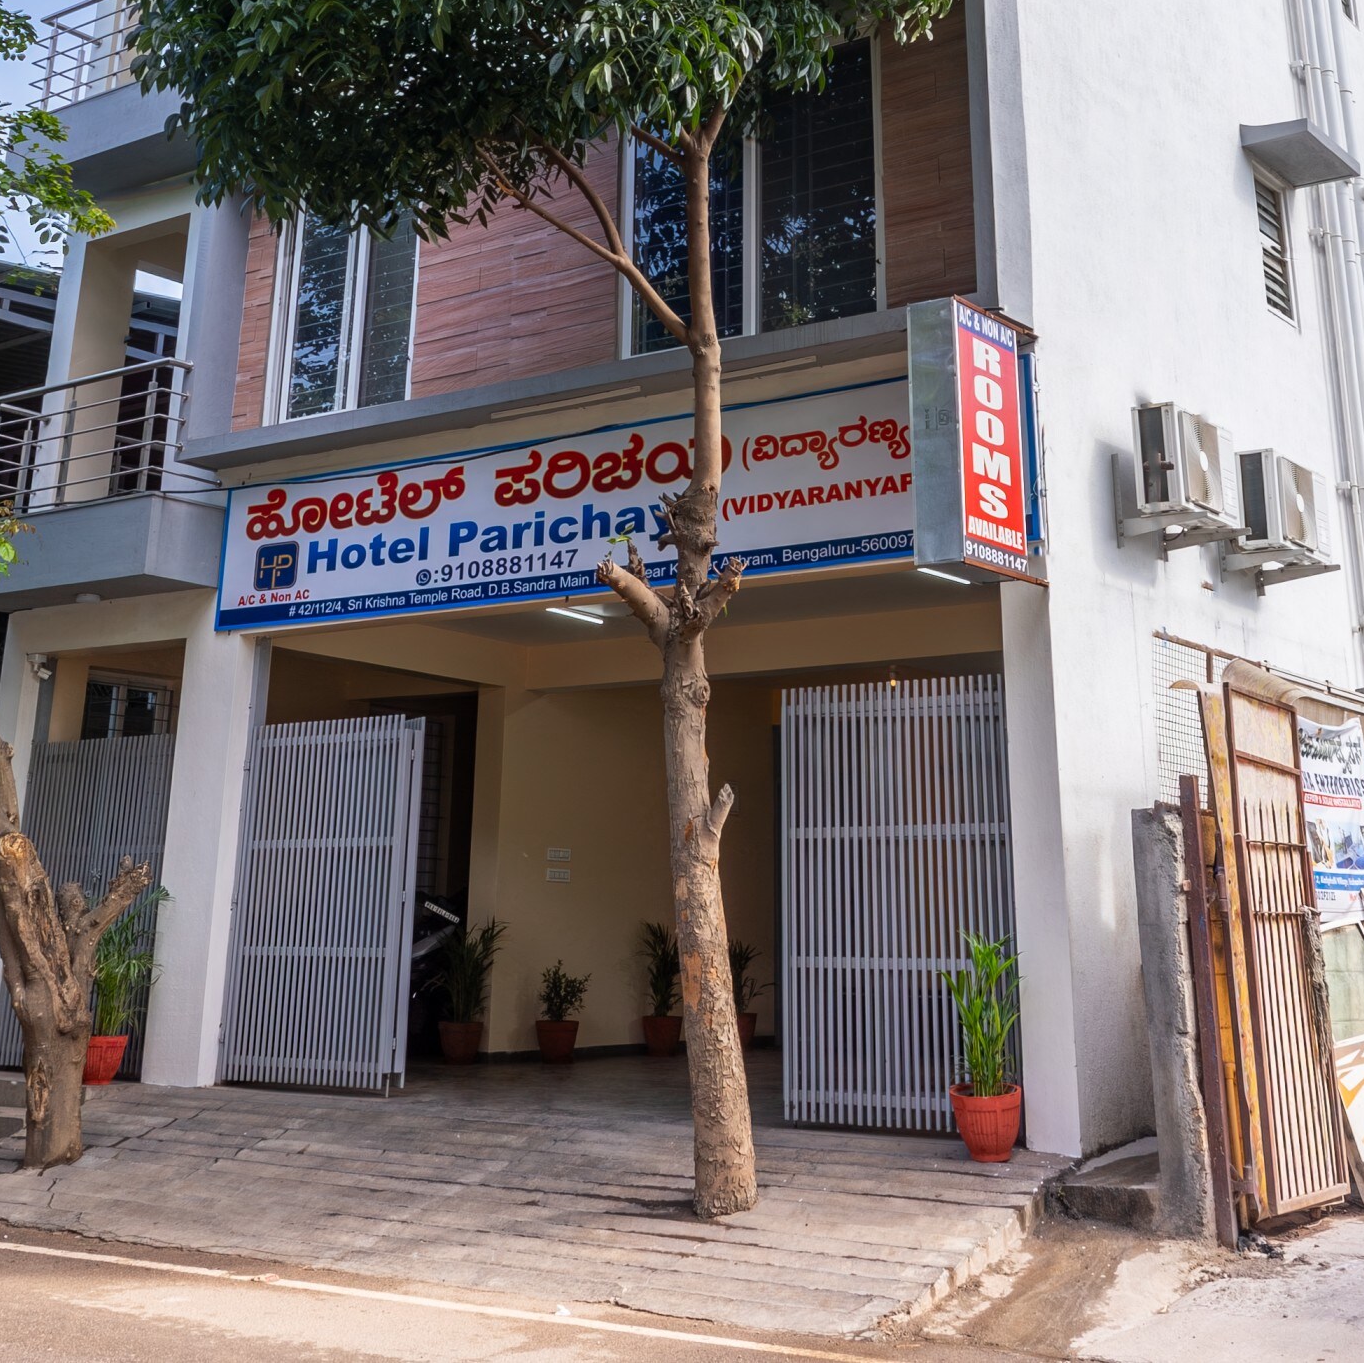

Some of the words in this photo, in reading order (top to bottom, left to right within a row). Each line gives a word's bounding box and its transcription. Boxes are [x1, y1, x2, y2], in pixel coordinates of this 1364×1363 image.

[959, 306, 972, 327] A/C
[974, 313, 980, 332] &
[982, 316, 999, 341] NON
[972, 336, 1011, 520] ROOMS
[246, 466, 466, 541] ಹೋಟೆಲ್
[307, 526, 430, 575] Hotel
[968, 515, 1024, 551] AVAILABLE
[289, 607, 296, 617] #
[298, 600, 345, 616] 42/112/4,
[348, 598, 363, 611] Sri
[365, 593, 406, 609] Krishna
[409, 589, 448, 606] Temple
[451, 585, 485, 602] Road,
[488, 579, 557, 597] D.B.Sandra
[560, 574, 590, 588] Main
[644, 566, 666, 579] ear
[783, 533, 914, 563] Bengaluru-560097
[966, 540, 1028, 573] 9108881147
[238, 592, 256, 607] A/C
[259, 594, 267, 604] &
[270, 591, 291, 603] Non
[295, 589, 310, 601] AC
